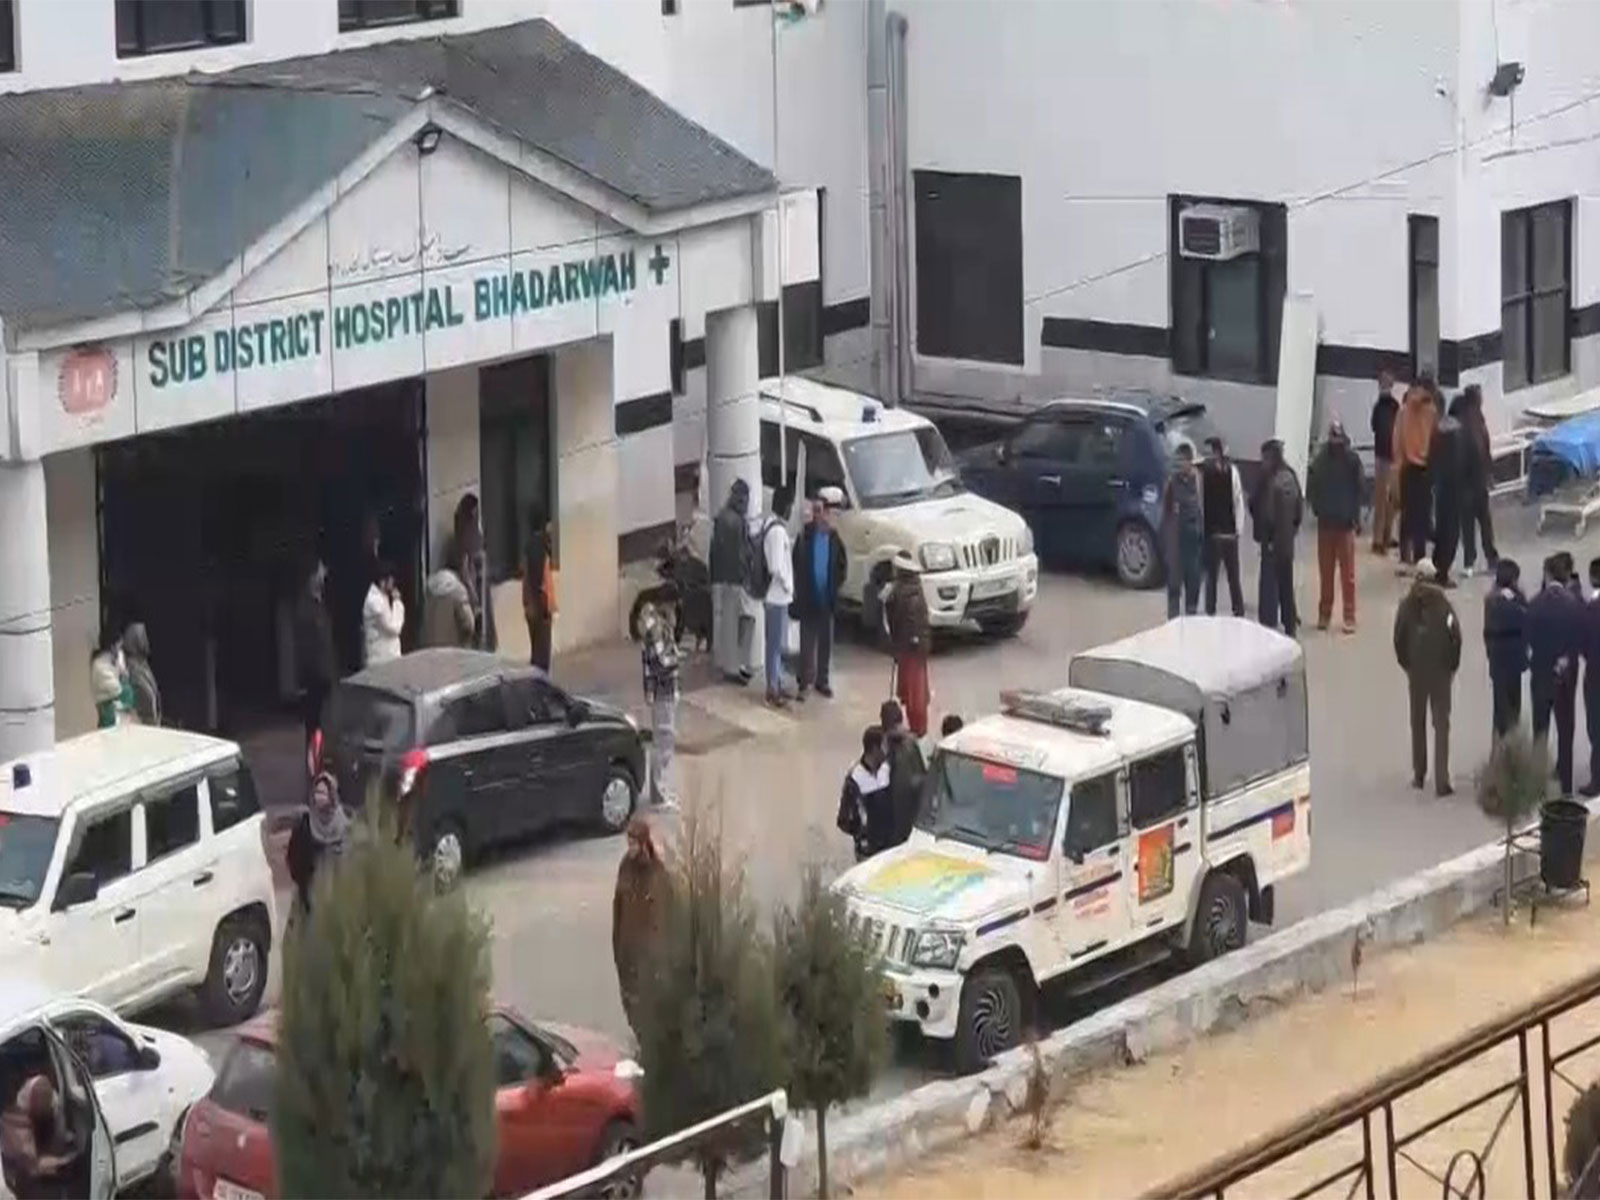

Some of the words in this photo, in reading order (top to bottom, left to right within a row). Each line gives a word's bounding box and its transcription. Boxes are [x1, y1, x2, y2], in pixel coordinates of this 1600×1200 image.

[148, 335, 208, 388] SUB
[214, 309, 324, 374] DISTRICT
[335, 286, 464, 349] HOSPITAL
[474, 252, 637, 322] BHADARWAH
